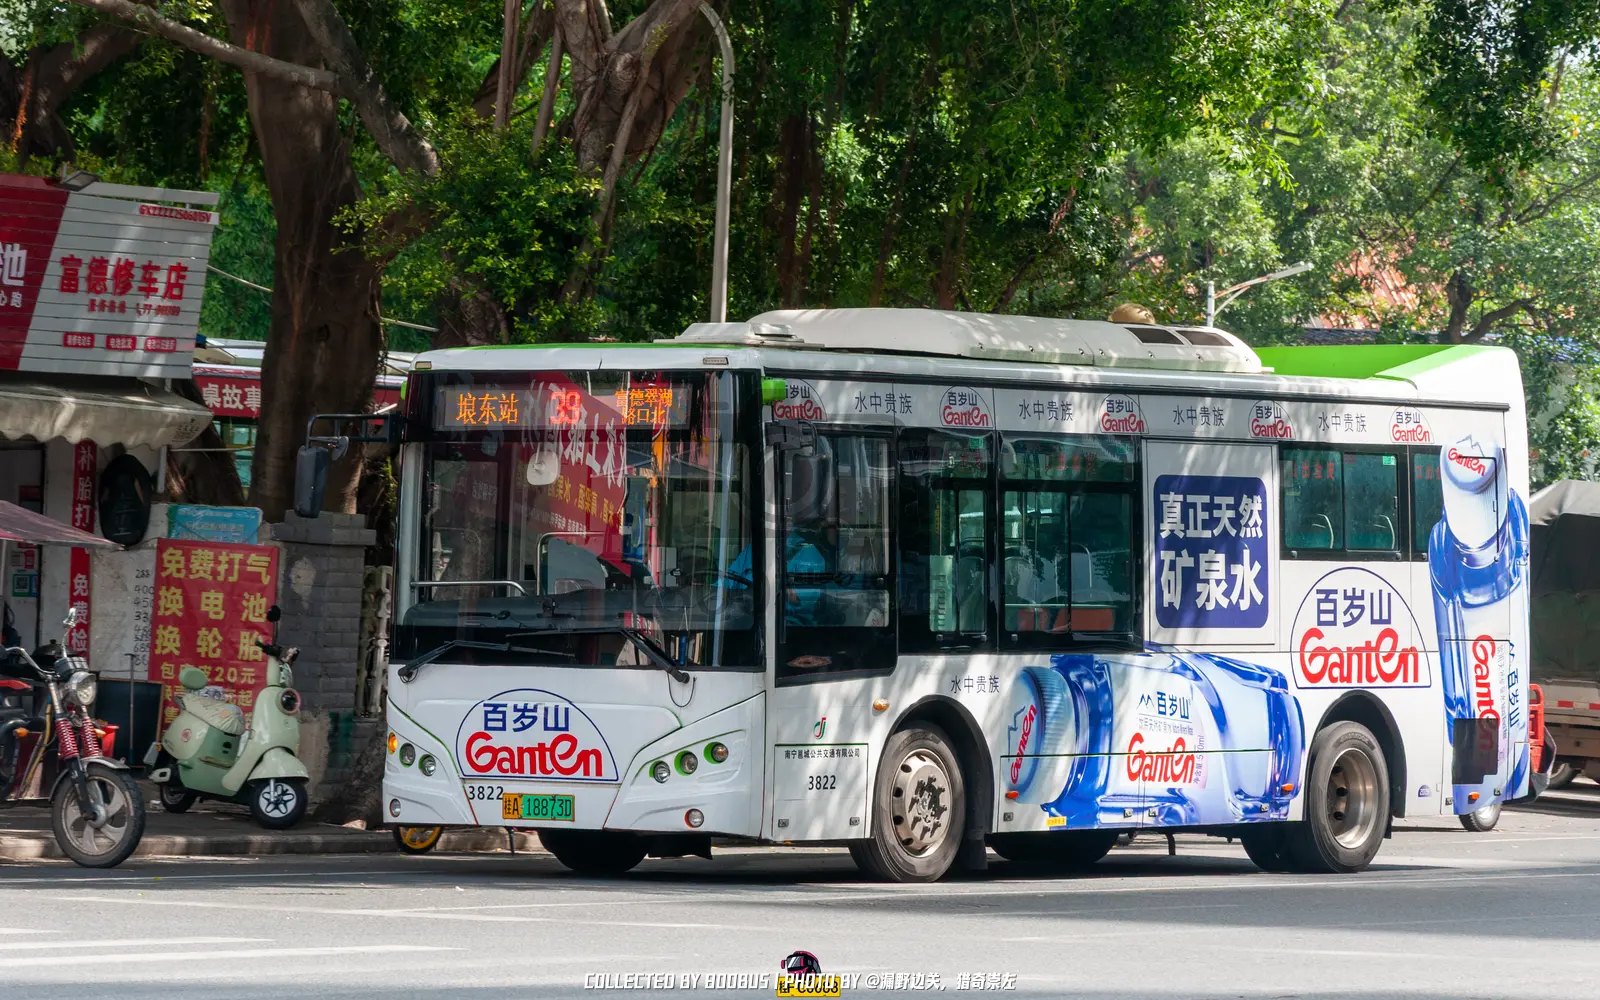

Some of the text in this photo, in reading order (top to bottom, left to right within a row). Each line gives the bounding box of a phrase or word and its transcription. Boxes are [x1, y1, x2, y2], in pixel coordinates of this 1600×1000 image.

[60, 254, 188, 300] 富德修车店
[456, 392, 519, 425] 埌东站
[549, 390, 581, 424] 39
[615, 388, 673, 407] 富德翠湖
[854, 391, 912, 414] 水中贵族
[947, 391, 978, 407] 百岁山
[1106, 399, 1134, 414] 百岁山
[773, 399, 823, 420] Ganten
[943, 404, 989, 426] Ganten
[1018, 399, 1073, 422] 水中贵族
[1173, 405, 1225, 427] 水中贵族
[1255, 405, 1282, 420] 百岁山
[1395, 410, 1421, 424] 百岁山
[1101, 412, 1145, 433] Ganten
[1251, 417, 1293, 438] Ganten
[1318, 411, 1368, 433] 水中贵族
[1391, 423, 1431, 443] Ganten
[1448, 447, 1486, 477] Ganten
[1159, 491, 1264, 540] 真正天然
[161, 547, 271, 585] 免费打气
[1160, 547, 1264, 612] 矿泉水
[158, 585, 267, 622] 换电池
[1315, 587, 1392, 628] 百岁山
[155, 624, 263, 661] 换轮胎
[1299, 627, 1419, 684] Ganten
[162, 662, 256, 684] 包皮20元
[950, 675, 1000, 694] 水中贵族
[1156, 691, 1190, 720] 百岁山
[483, 703, 570, 733] 百岁山
[465, 731, 603, 777] Ganten
[784, 748, 860, 760] 南宁邕城公共交通有限公司
[1010, 704, 1037, 785] Ganten
[1127, 732, 1195, 783] Ganten
[468, 785, 504, 800] 3822
[808, 775, 836, 790] 3822
